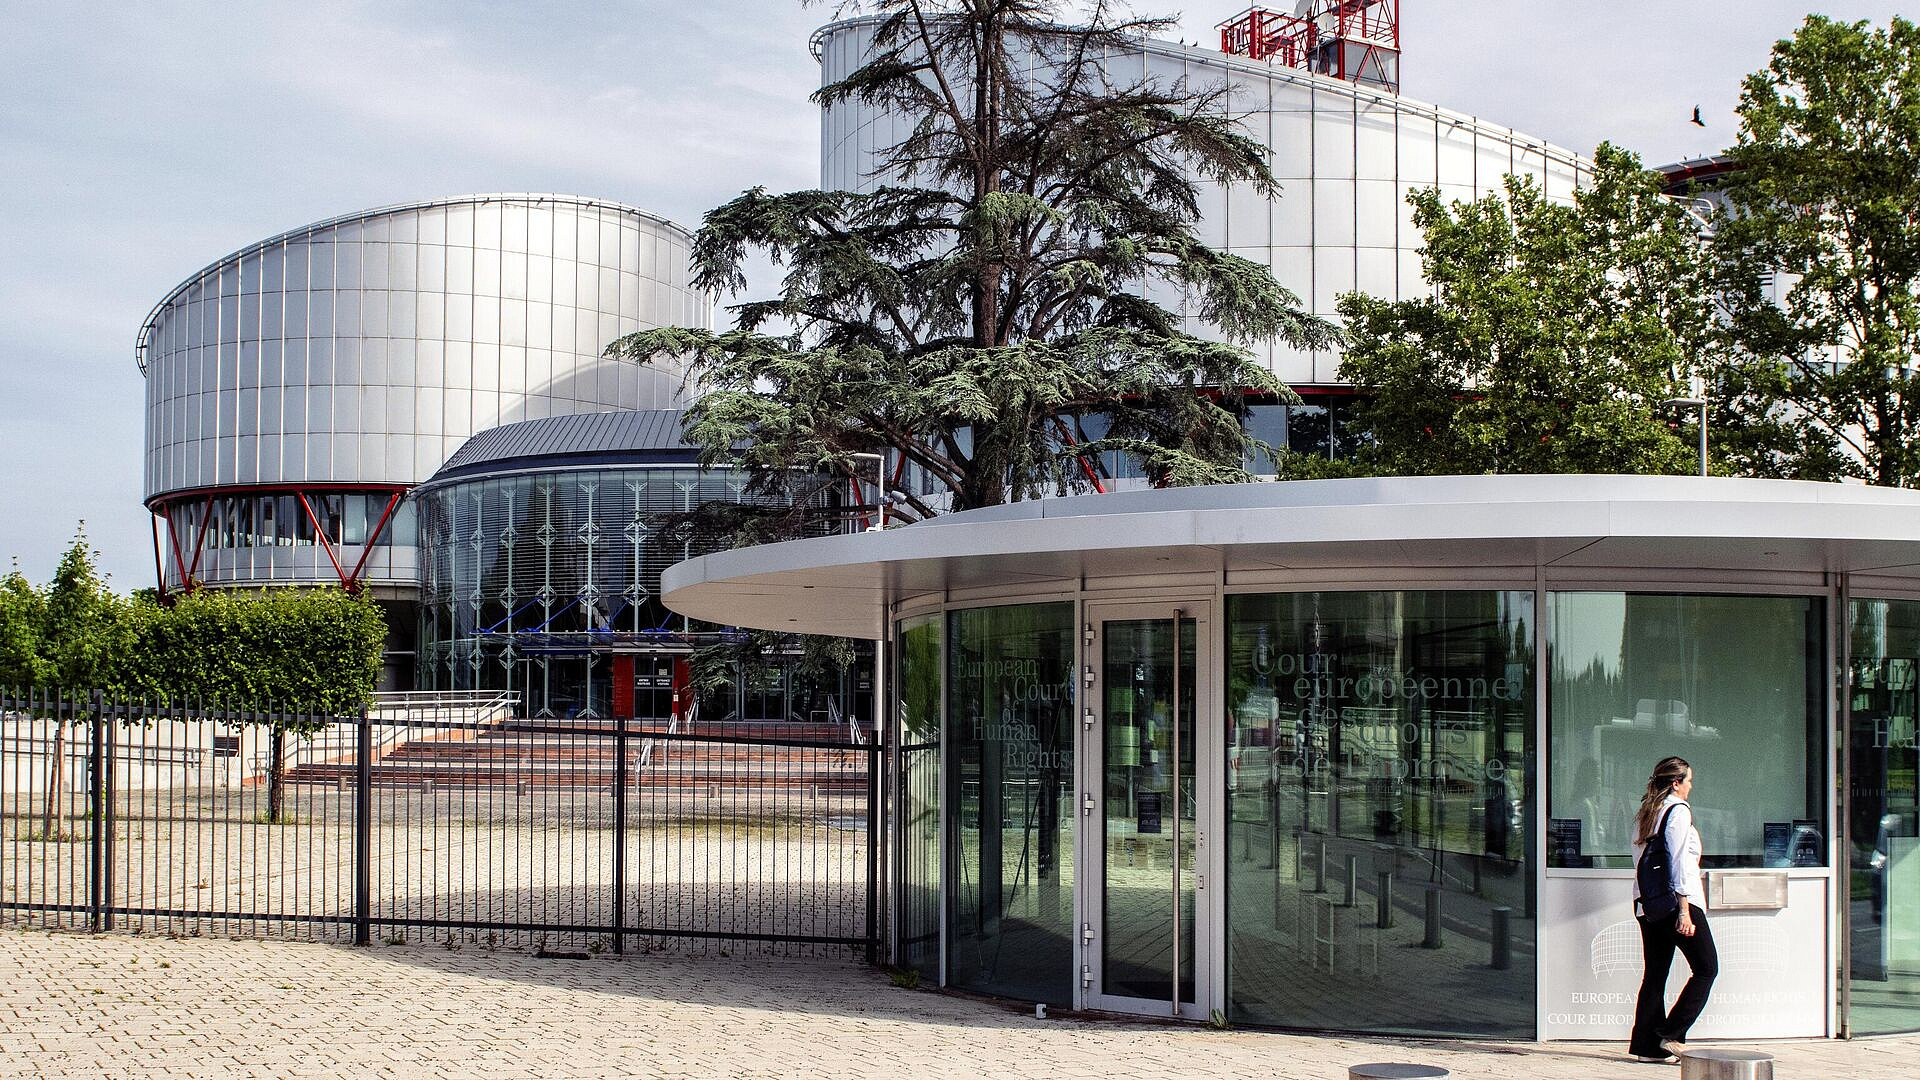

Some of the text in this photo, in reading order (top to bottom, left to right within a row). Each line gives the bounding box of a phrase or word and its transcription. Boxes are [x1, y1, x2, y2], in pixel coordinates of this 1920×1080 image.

[959, 655, 1038, 682] European
[1252, 644, 1338, 675] Cour
[1015, 677, 1071, 702] Court
[1293, 667, 1511, 706] européenne
[1003, 700, 1019, 724] of
[1300, 698, 1356, 728] des
[973, 716, 1039, 741] Human
[1005, 742, 1072, 774] Rights
[1292, 746, 1331, 778] de
[1712, 992, 1762, 1005] HUMAN
[1547, 1013, 1586, 1025] COUR
